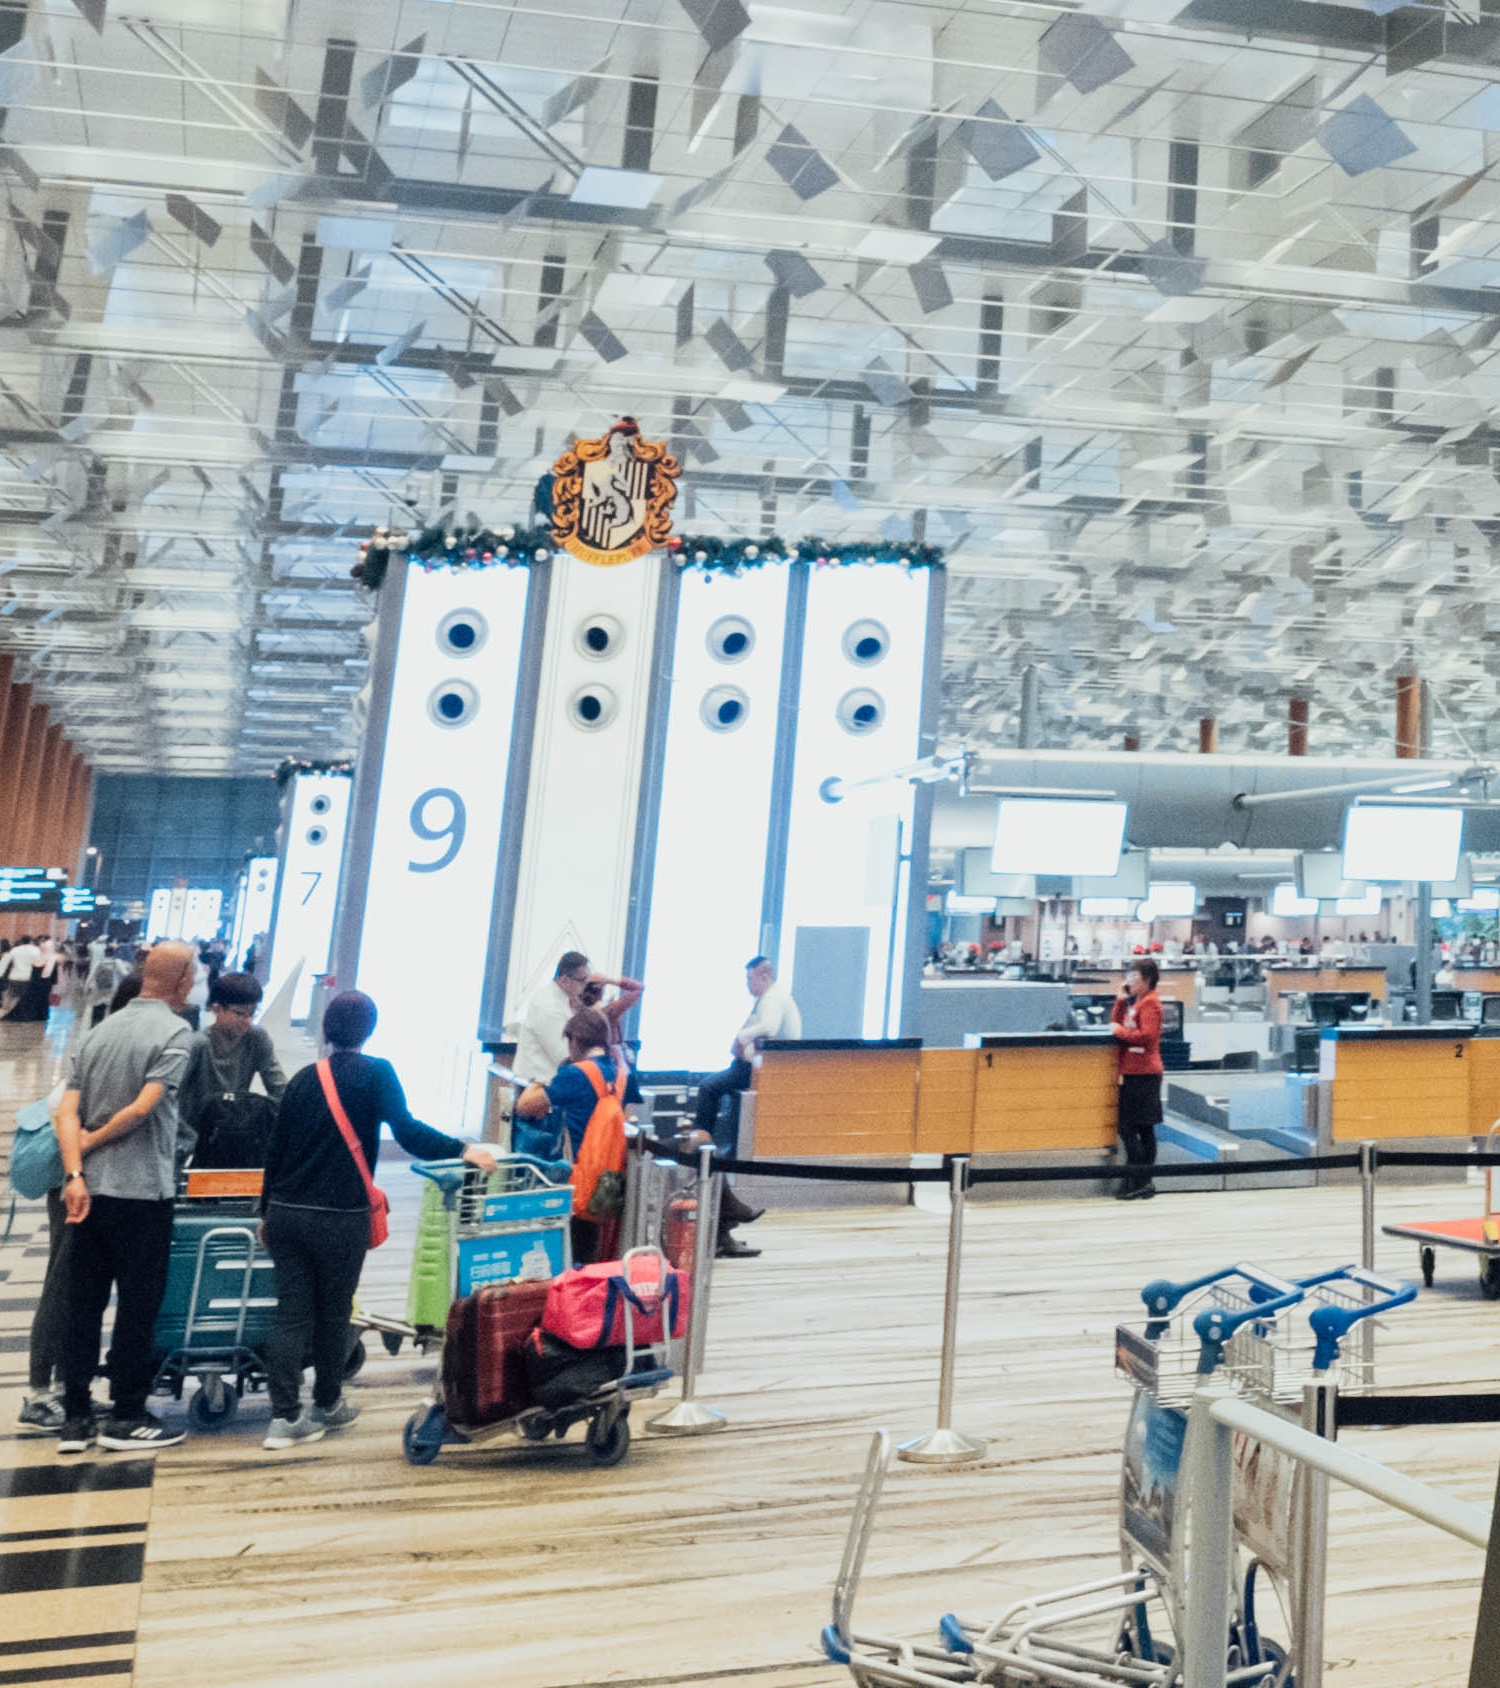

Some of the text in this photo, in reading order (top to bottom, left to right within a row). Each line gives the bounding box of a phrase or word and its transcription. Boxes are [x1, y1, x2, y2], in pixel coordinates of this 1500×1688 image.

[407, 787, 467, 873] 9
[300, 871, 322, 906] 7
[1455, 1044, 1464, 1058] 2
